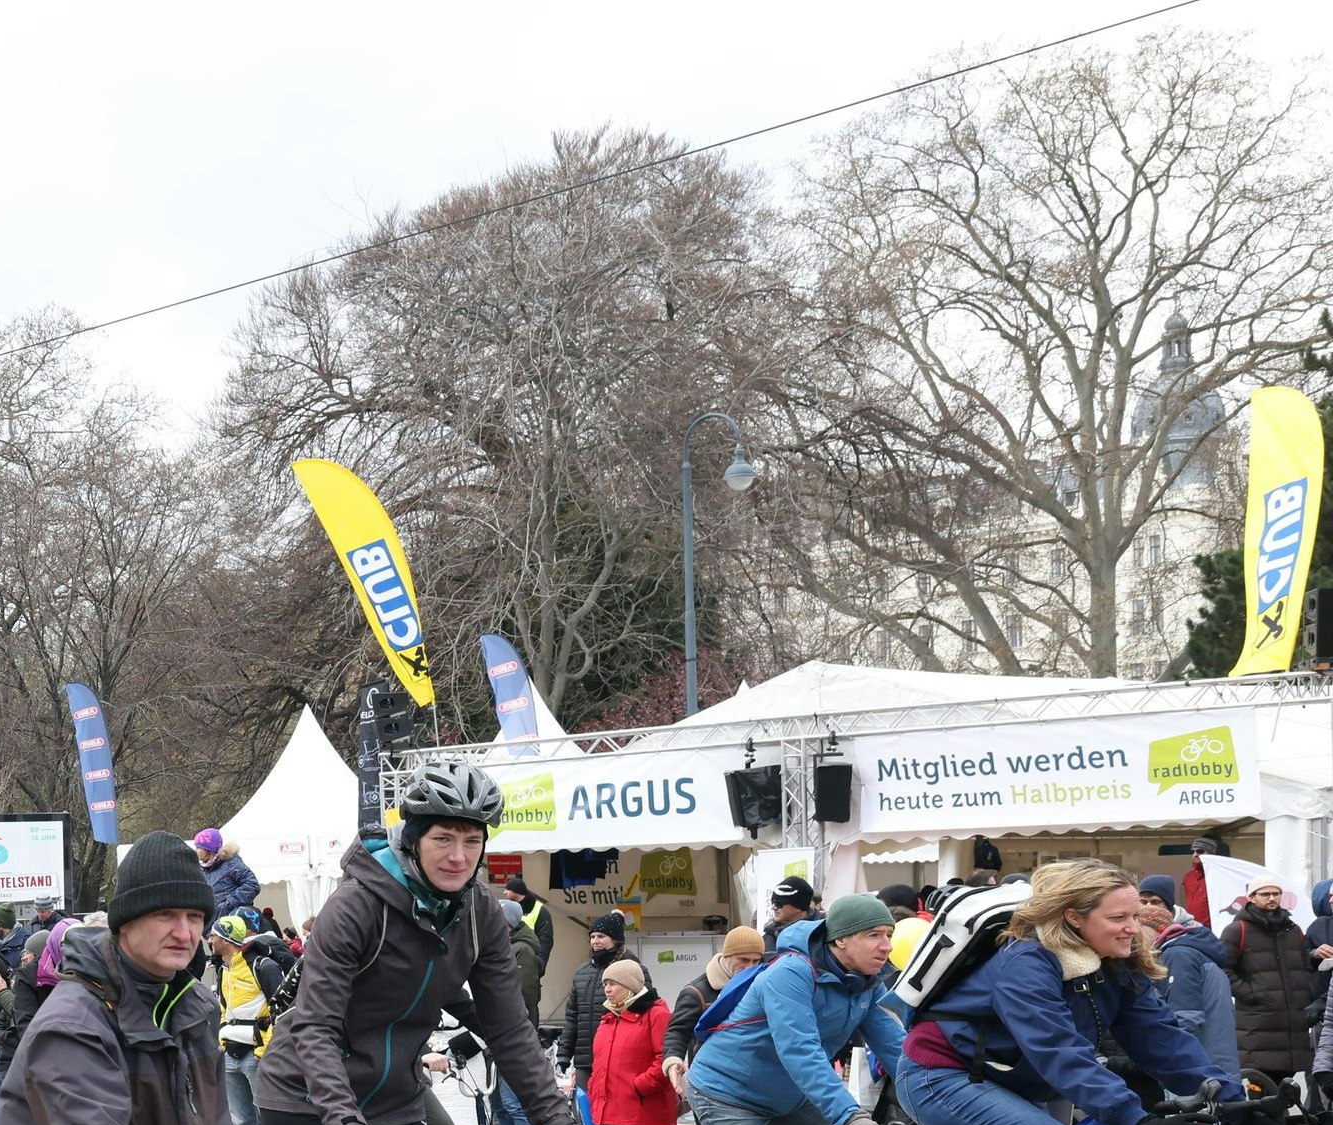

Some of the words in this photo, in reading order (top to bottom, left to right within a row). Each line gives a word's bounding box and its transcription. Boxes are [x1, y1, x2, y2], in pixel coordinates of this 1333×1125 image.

[1258, 484, 1303, 606] CLUB
[351, 545, 419, 648] CLUB
[877, 752, 997, 785] Mitglied
[1006, 746, 1128, 774] werden
[1152, 760, 1234, 779] radlobby
[568, 777, 697, 820] ARGUS
[878, 789, 948, 812] heute
[951, 789, 1002, 808] zum
[1010, 780, 1132, 808] Halbpreis
[1178, 788, 1235, 806] ARGUS
[501, 809, 553, 824] dlobby
[642, 875, 693, 890] radlobby
[564, 888, 588, 904] Sie
[675, 953, 698, 962] ARGUS
